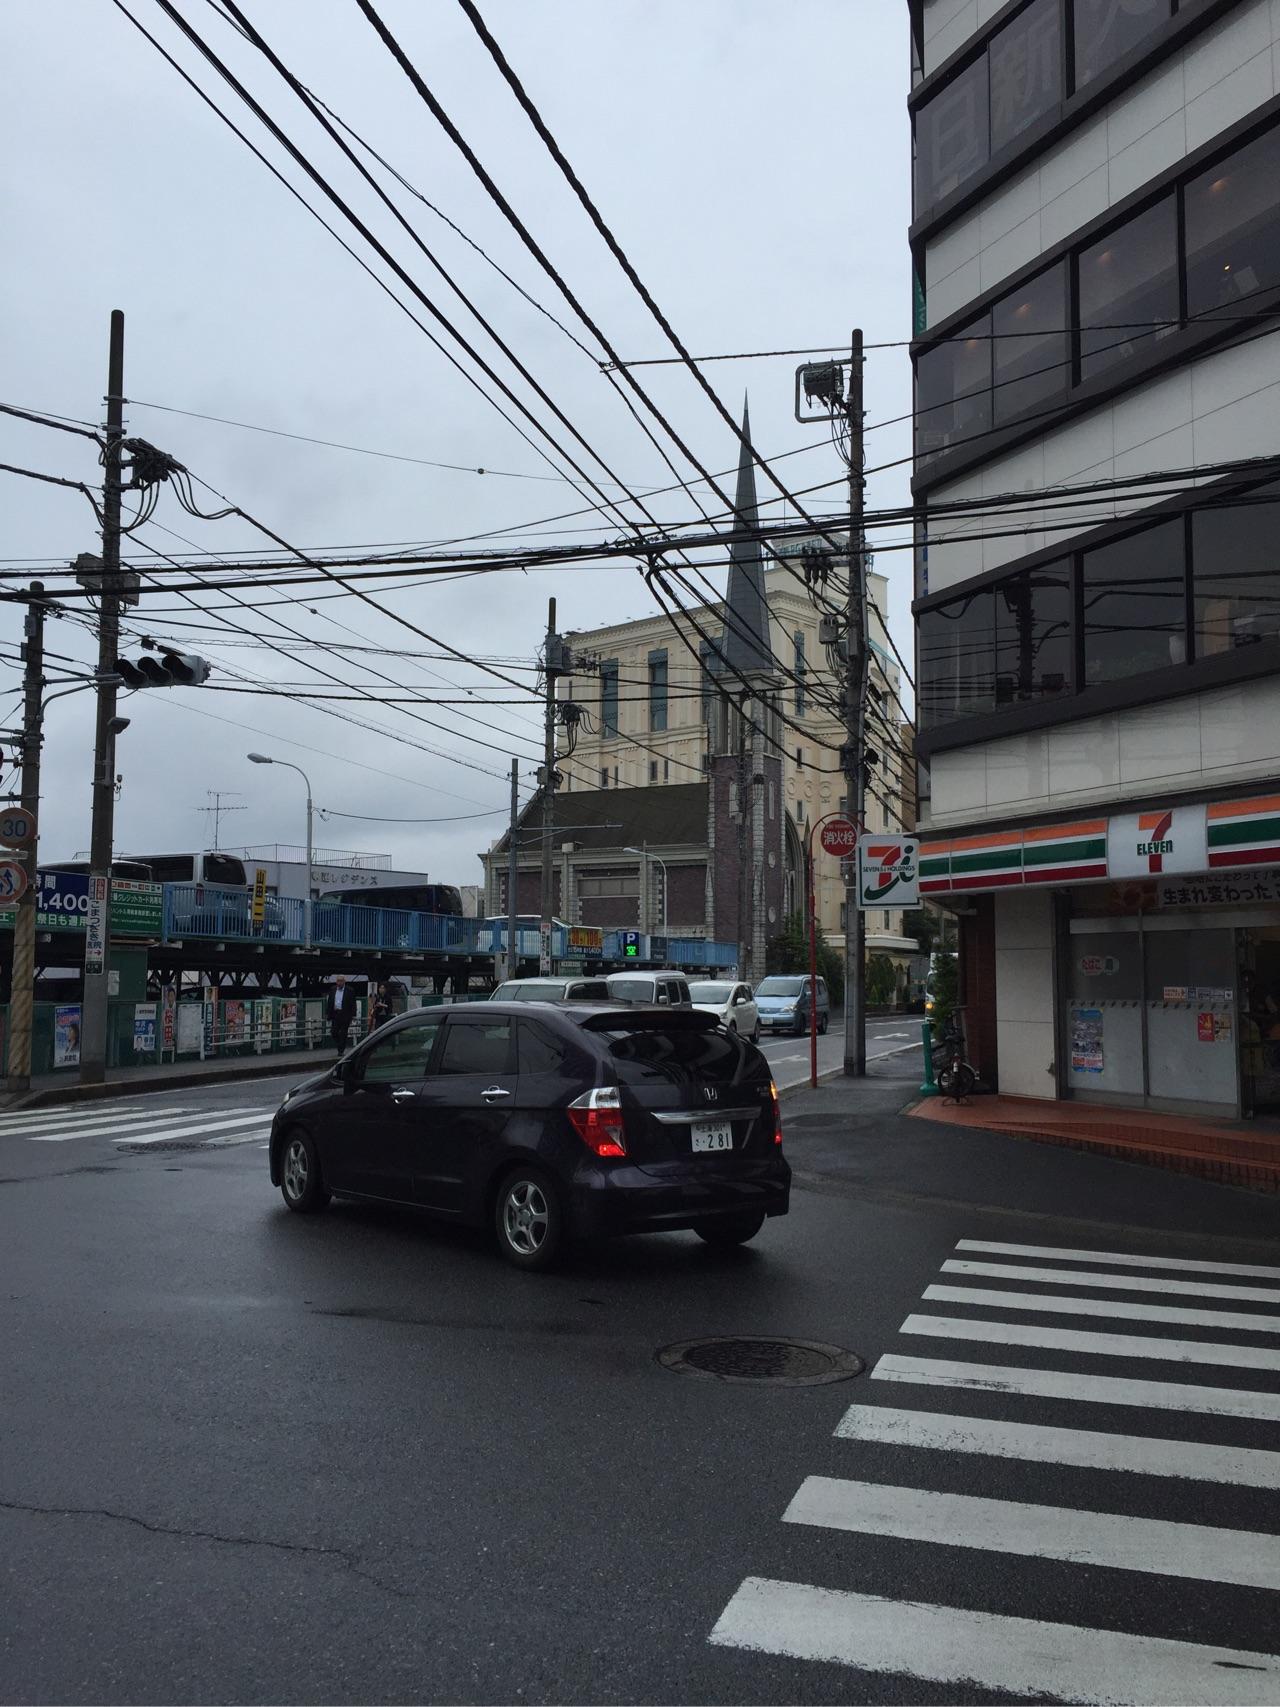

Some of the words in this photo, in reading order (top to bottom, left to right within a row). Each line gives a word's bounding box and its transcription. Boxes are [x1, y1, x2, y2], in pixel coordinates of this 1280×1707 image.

[2, 820, 26, 837] 30
[823, 831, 855, 845] 消火栓
[626, 933, 636, 944] P
